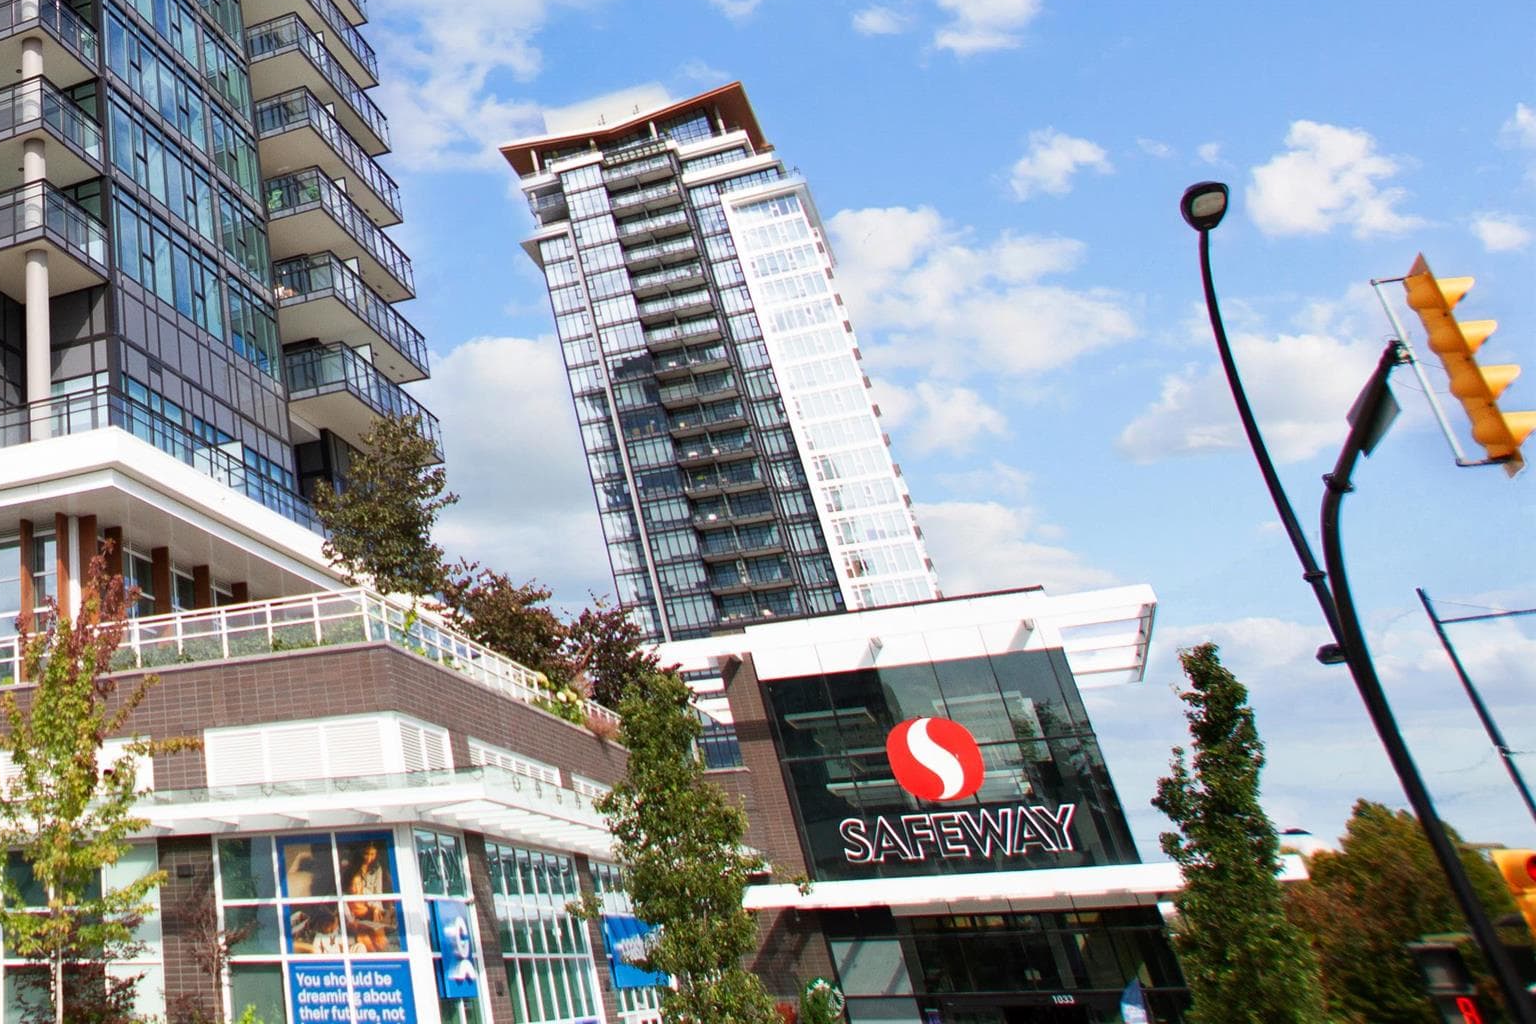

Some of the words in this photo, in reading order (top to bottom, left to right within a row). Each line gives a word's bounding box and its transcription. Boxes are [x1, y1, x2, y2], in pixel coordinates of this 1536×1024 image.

[839, 803, 1076, 863] SAFEWAY
[296, 972, 320, 986] You
[323, 971, 374, 986] should
[375, 971, 392, 986] be
[298, 988, 362, 1006] dreaming
[363, 988, 403, 1003] about
[1052, 994, 1074, 1004] 1033
[299, 1005, 329, 1020] their
[331, 1004, 381, 1022] future,
[382, 1005, 406, 1021] not
